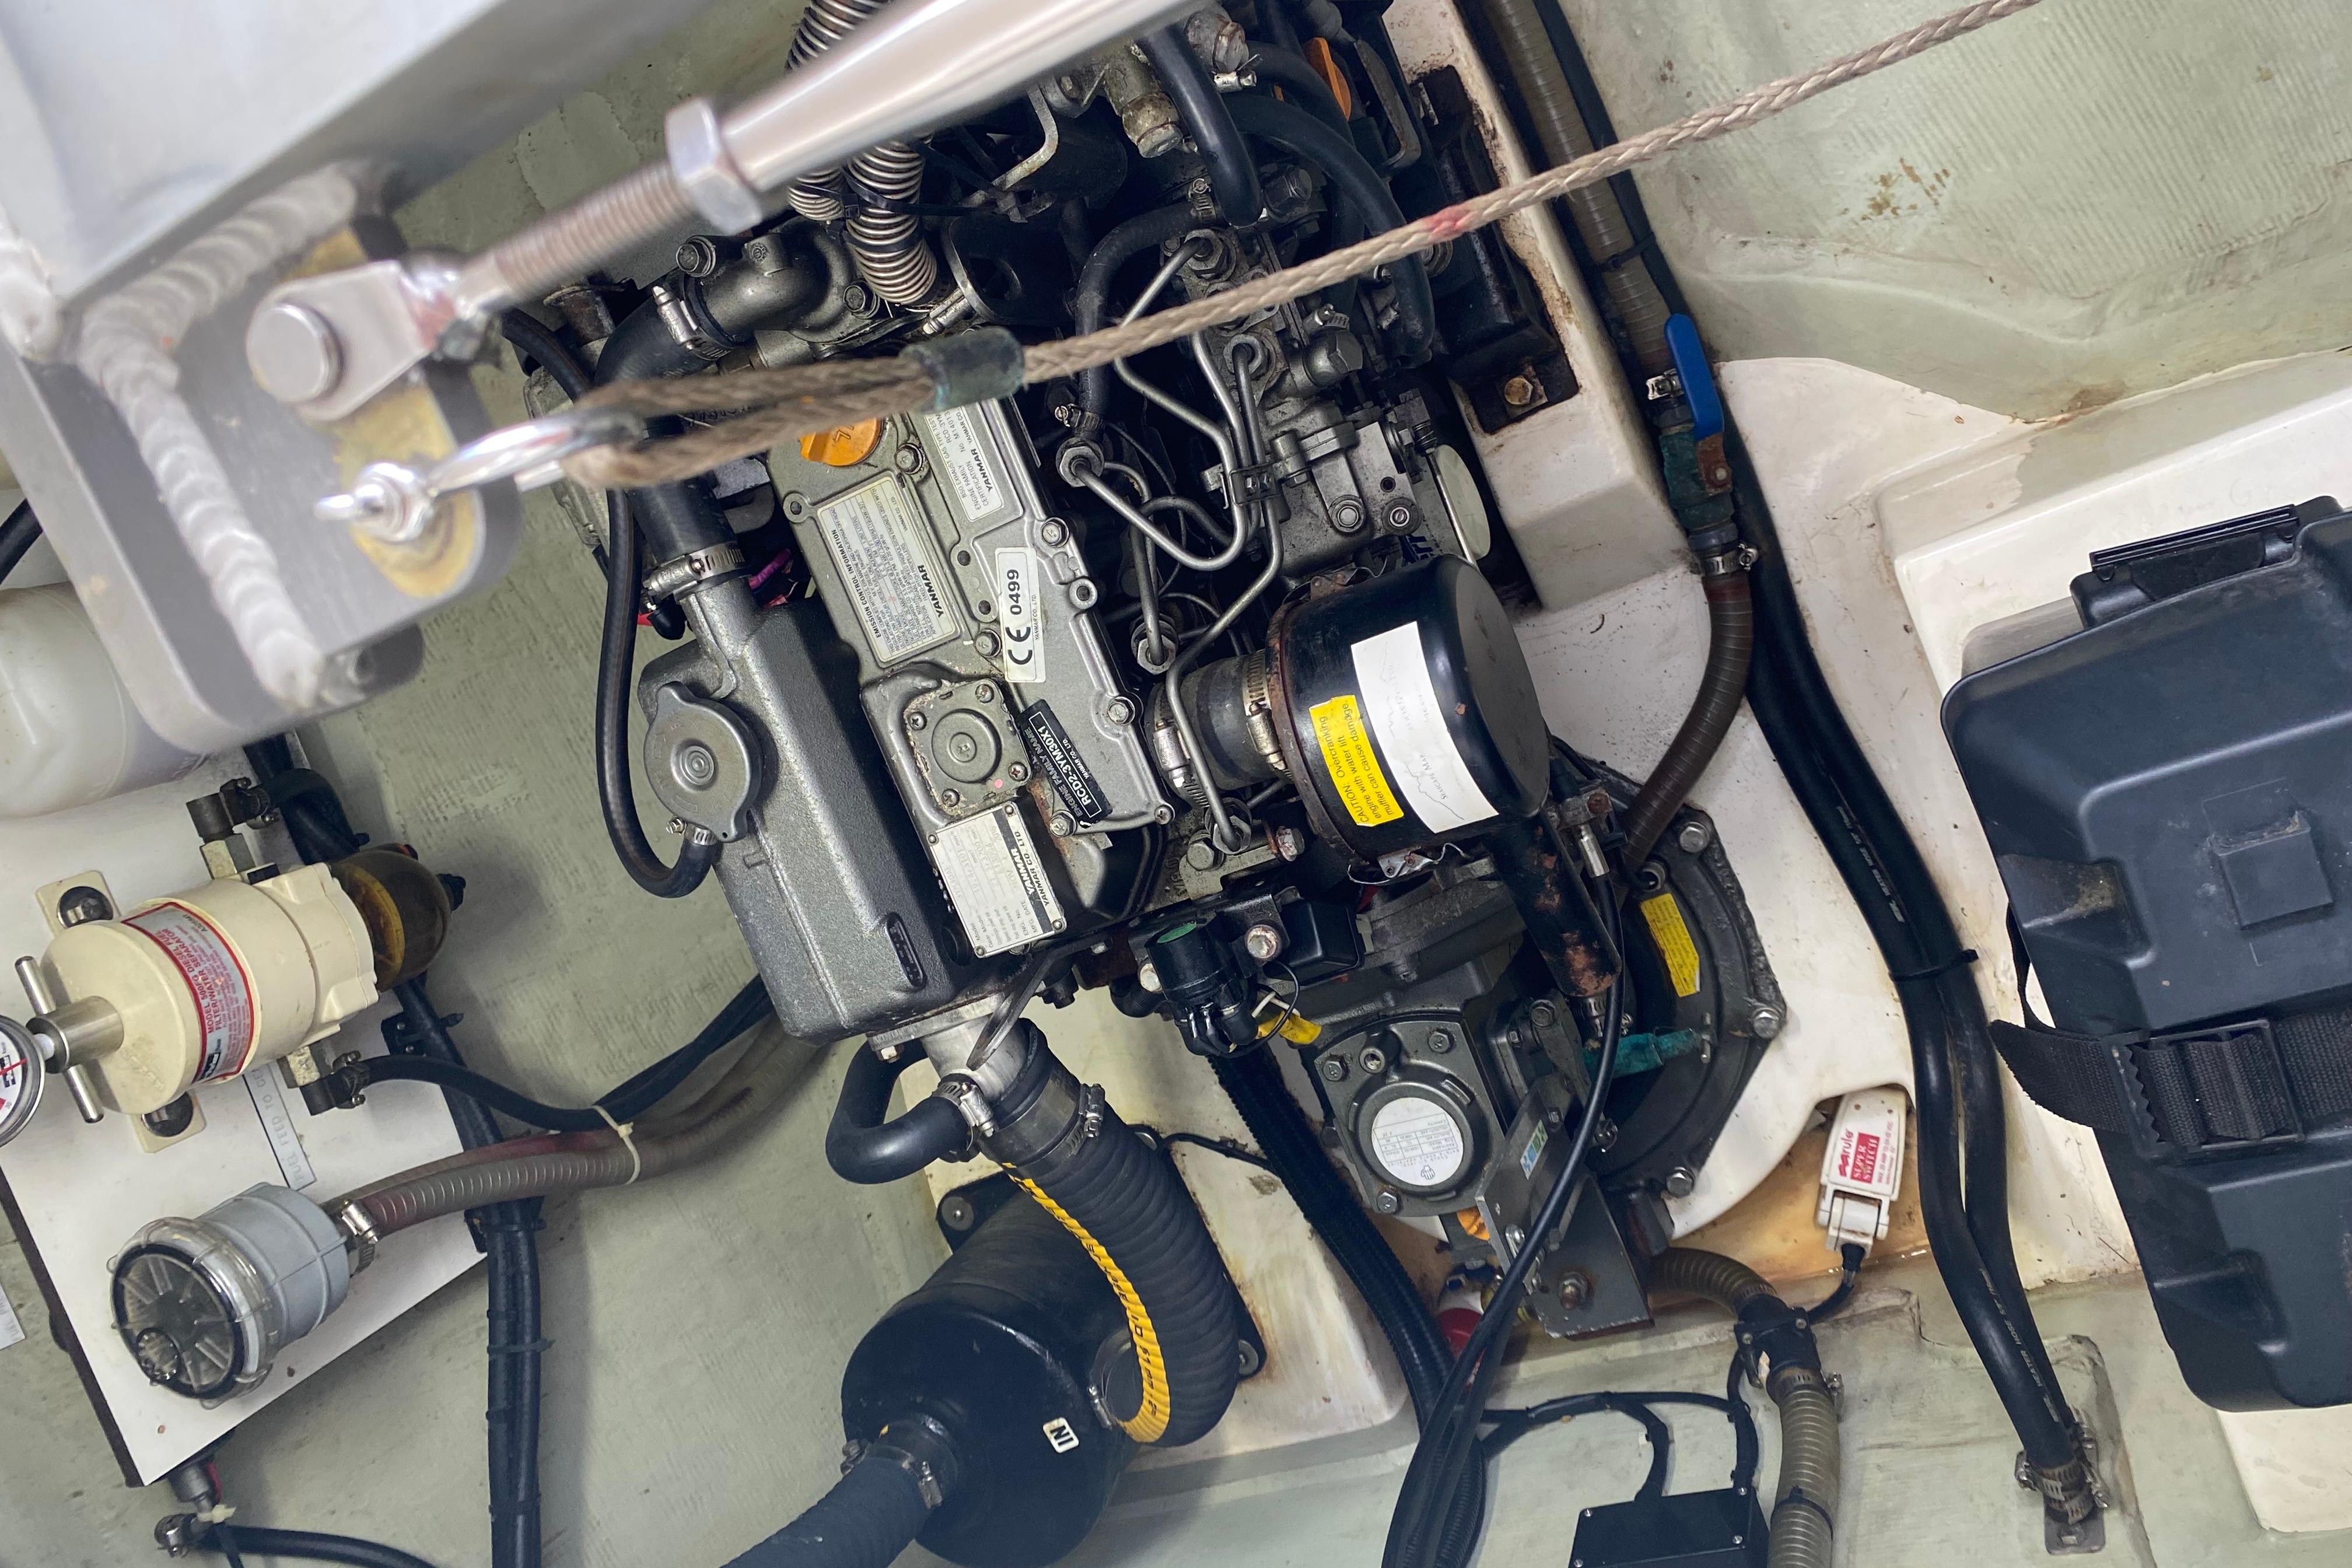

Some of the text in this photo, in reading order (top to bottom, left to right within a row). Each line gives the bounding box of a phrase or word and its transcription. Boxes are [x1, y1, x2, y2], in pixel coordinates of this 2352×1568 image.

[928, 416, 939, 430] TEST
[960, 421, 972, 443] YANMAR
[934, 432, 944, 445] TYPE
[940, 446, 950, 459] GAS
[946, 460, 961, 485] EXHAUST
[957, 464, 971, 486] FAMILY
[970, 448, 993, 492] YANMAR
[871, 488, 880, 501] WITH
[965, 460, 989, 507] CERTIFICATION
[877, 501, 886, 514] USED
[967, 487, 981, 510] ENGINE
[882, 514, 894, 534] ENGINES
[838, 527, 852, 552] CALIFORNIA
[890, 534, 907, 565] PROPULSION
[854, 549, 866, 570] ENGINES
[864, 546, 882, 579] DISPLACEMENT
[898, 513, 945, 617] YANMAR YANMAR
[900, 542, 916, 573] PROPELLERS
[853, 561, 863, 578] MARINE
[863, 569, 873, 586] DIESEL
[831, 529, 881, 638] EMISSION CONTROL INFORMATION
[871, 576, 879, 587] FUEL
[1006, 569, 1021, 615] 0499
[867, 595, 876, 607] WITH
[876, 587, 886, 603] DIESEL
[872, 606, 885, 628] COMPLIES
[883, 604, 894, 622] SULFUR
[894, 614, 904, 629] FAMILY
[898, 610, 909, 626] MODEL
[908, 604, 923, 630] STANDARDS
[921, 605, 937, 635] APPLICATION
[881, 627, 891, 643] ENGINE
[884, 619, 900, 651] REGULATIONS
[891, 622, 900, 634] LOW
[901, 629, 911, 646] ENGINE
[905, 627, 916, 643] ENGINE
[895, 634, 905, 649] ULTRA
[1318, 716, 1346, 778] Overcranking
[1340, 699, 1394, 815] muffler can cause damage.
[1023, 727, 1083, 816] ENGINE FAMILY NAME
[1037, 725, 1093, 804] RCD2-3YM30X1
[1073, 758, 1090, 779] YANMAR
[1336, 734, 1382, 818] engine with water lift
[988, 824, 1001, 842] 2016
[1010, 846, 1035, 895] YANMAR
[1029, 867, 1050, 907] YANMAR
[1020, 900, 1031, 915] DATE
[154, 929, 173, 947] FUEL
[970, 922, 981, 941] Model
[977, 914, 993, 947] Gear Model
[162, 926, 201, 968] SEPARATOR
[172, 945, 194, 974] DIESEL
[191, 973, 208, 1000] 500FG
[205, 1002, 215, 1034] MODEL
[263, 1094, 273, 1110] TO
[271, 1115, 289, 1146] FEED
[1840, 1128, 1854, 1158] rule
[1853, 1145, 1866, 1178] SUPER
[1863, 1139, 1878, 1181] SWITCH
[2004, 1317, 2043, 1388] HEATER HOSE
[1049, 1425, 1074, 1447] IN
